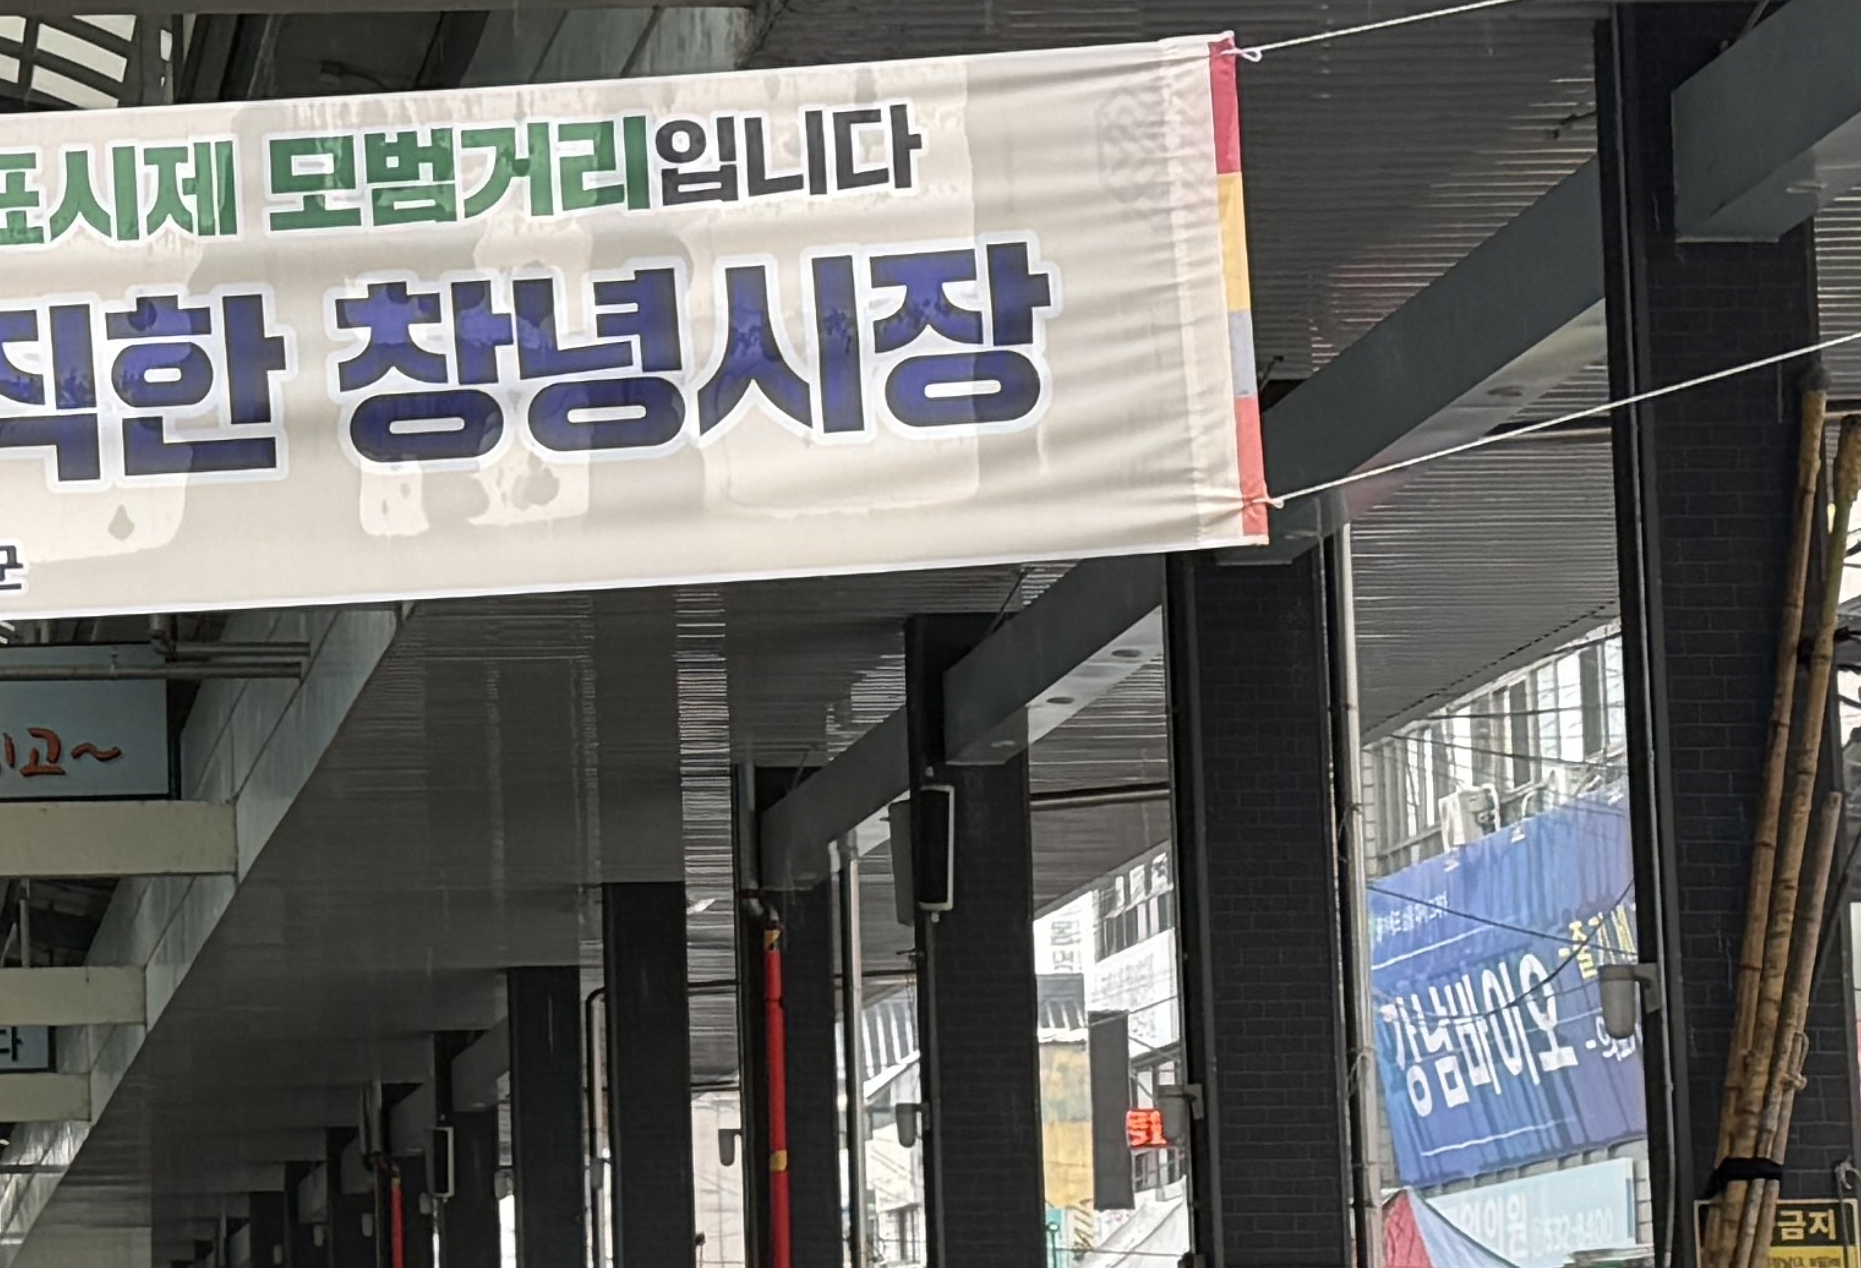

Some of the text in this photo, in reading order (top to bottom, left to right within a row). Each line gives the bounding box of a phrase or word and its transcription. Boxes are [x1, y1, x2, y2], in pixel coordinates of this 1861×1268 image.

[269, 104, 922, 230] 모범거리입니다
[336, 243, 1051, 463] 창녕시장
[1777, 1209, 1837, 1241] 금지
